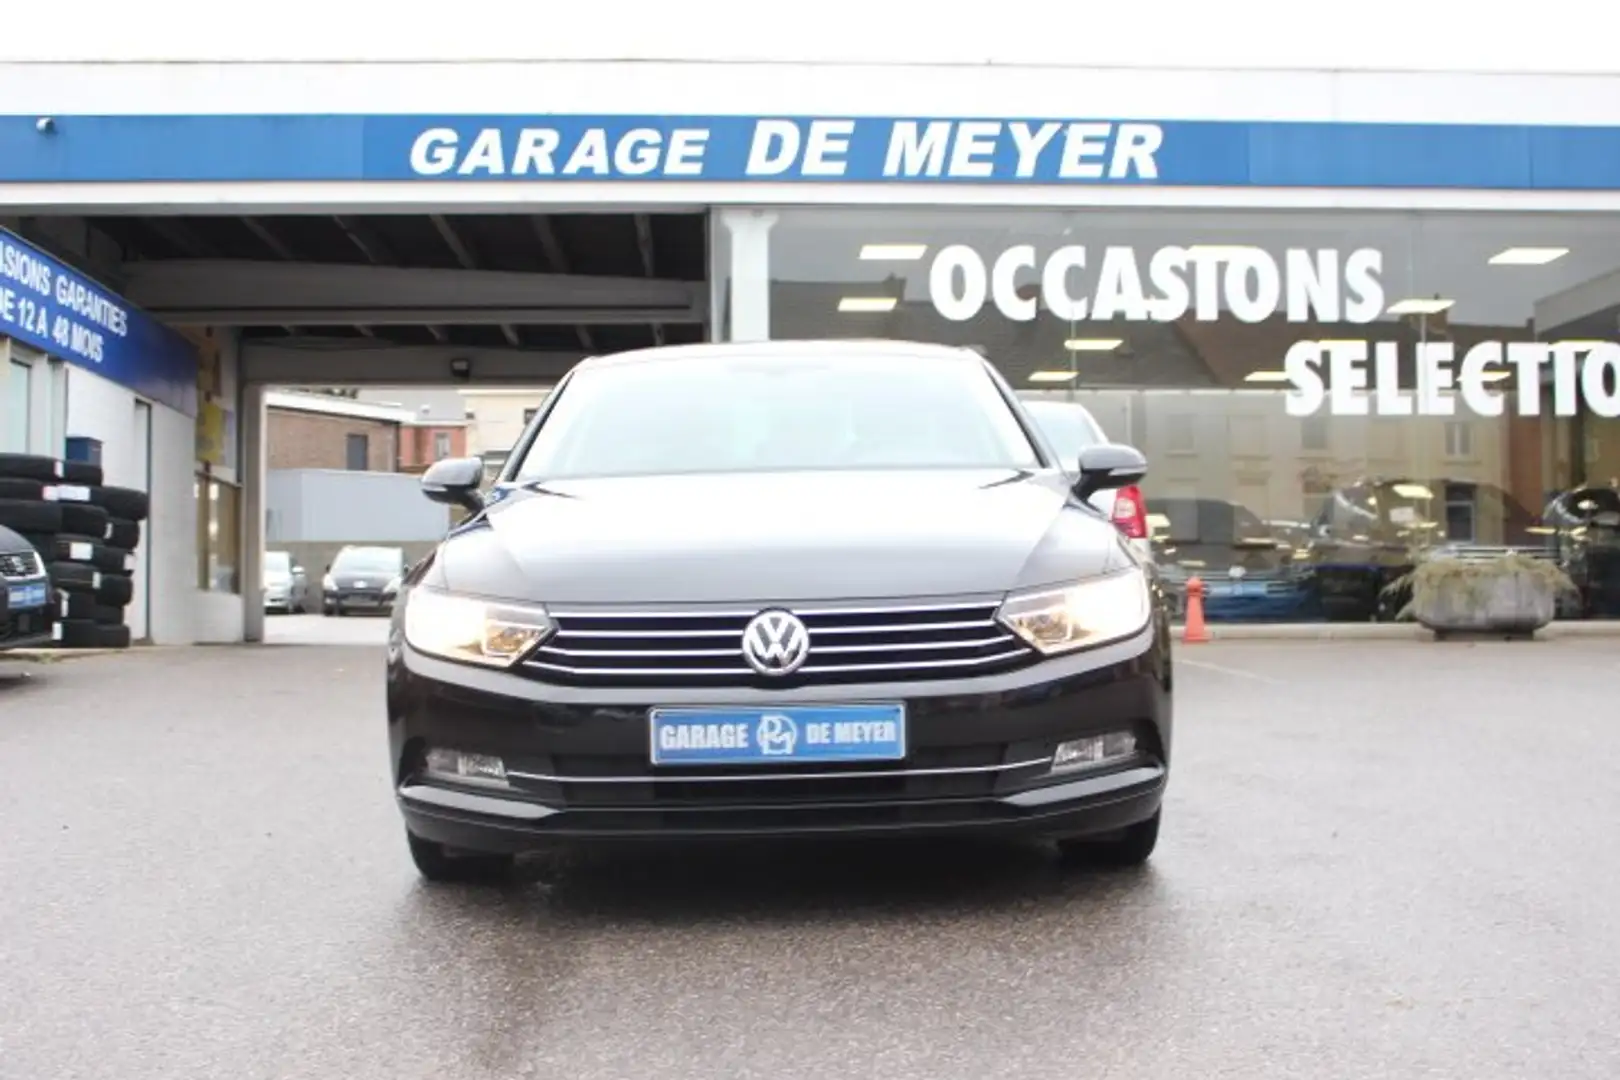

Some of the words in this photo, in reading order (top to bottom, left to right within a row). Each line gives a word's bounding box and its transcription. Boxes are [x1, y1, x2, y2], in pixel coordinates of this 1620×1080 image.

[409, 127, 710, 176] GARAGE
[745, 119, 856, 176] DE
[882, 120, 1165, 179] MEYER
[55, 274, 128, 337] GARANTIES
[660, 723, 749, 751] GARAGE
[806, 722, 832, 744] DE
[833, 720, 897, 744] MEYER
